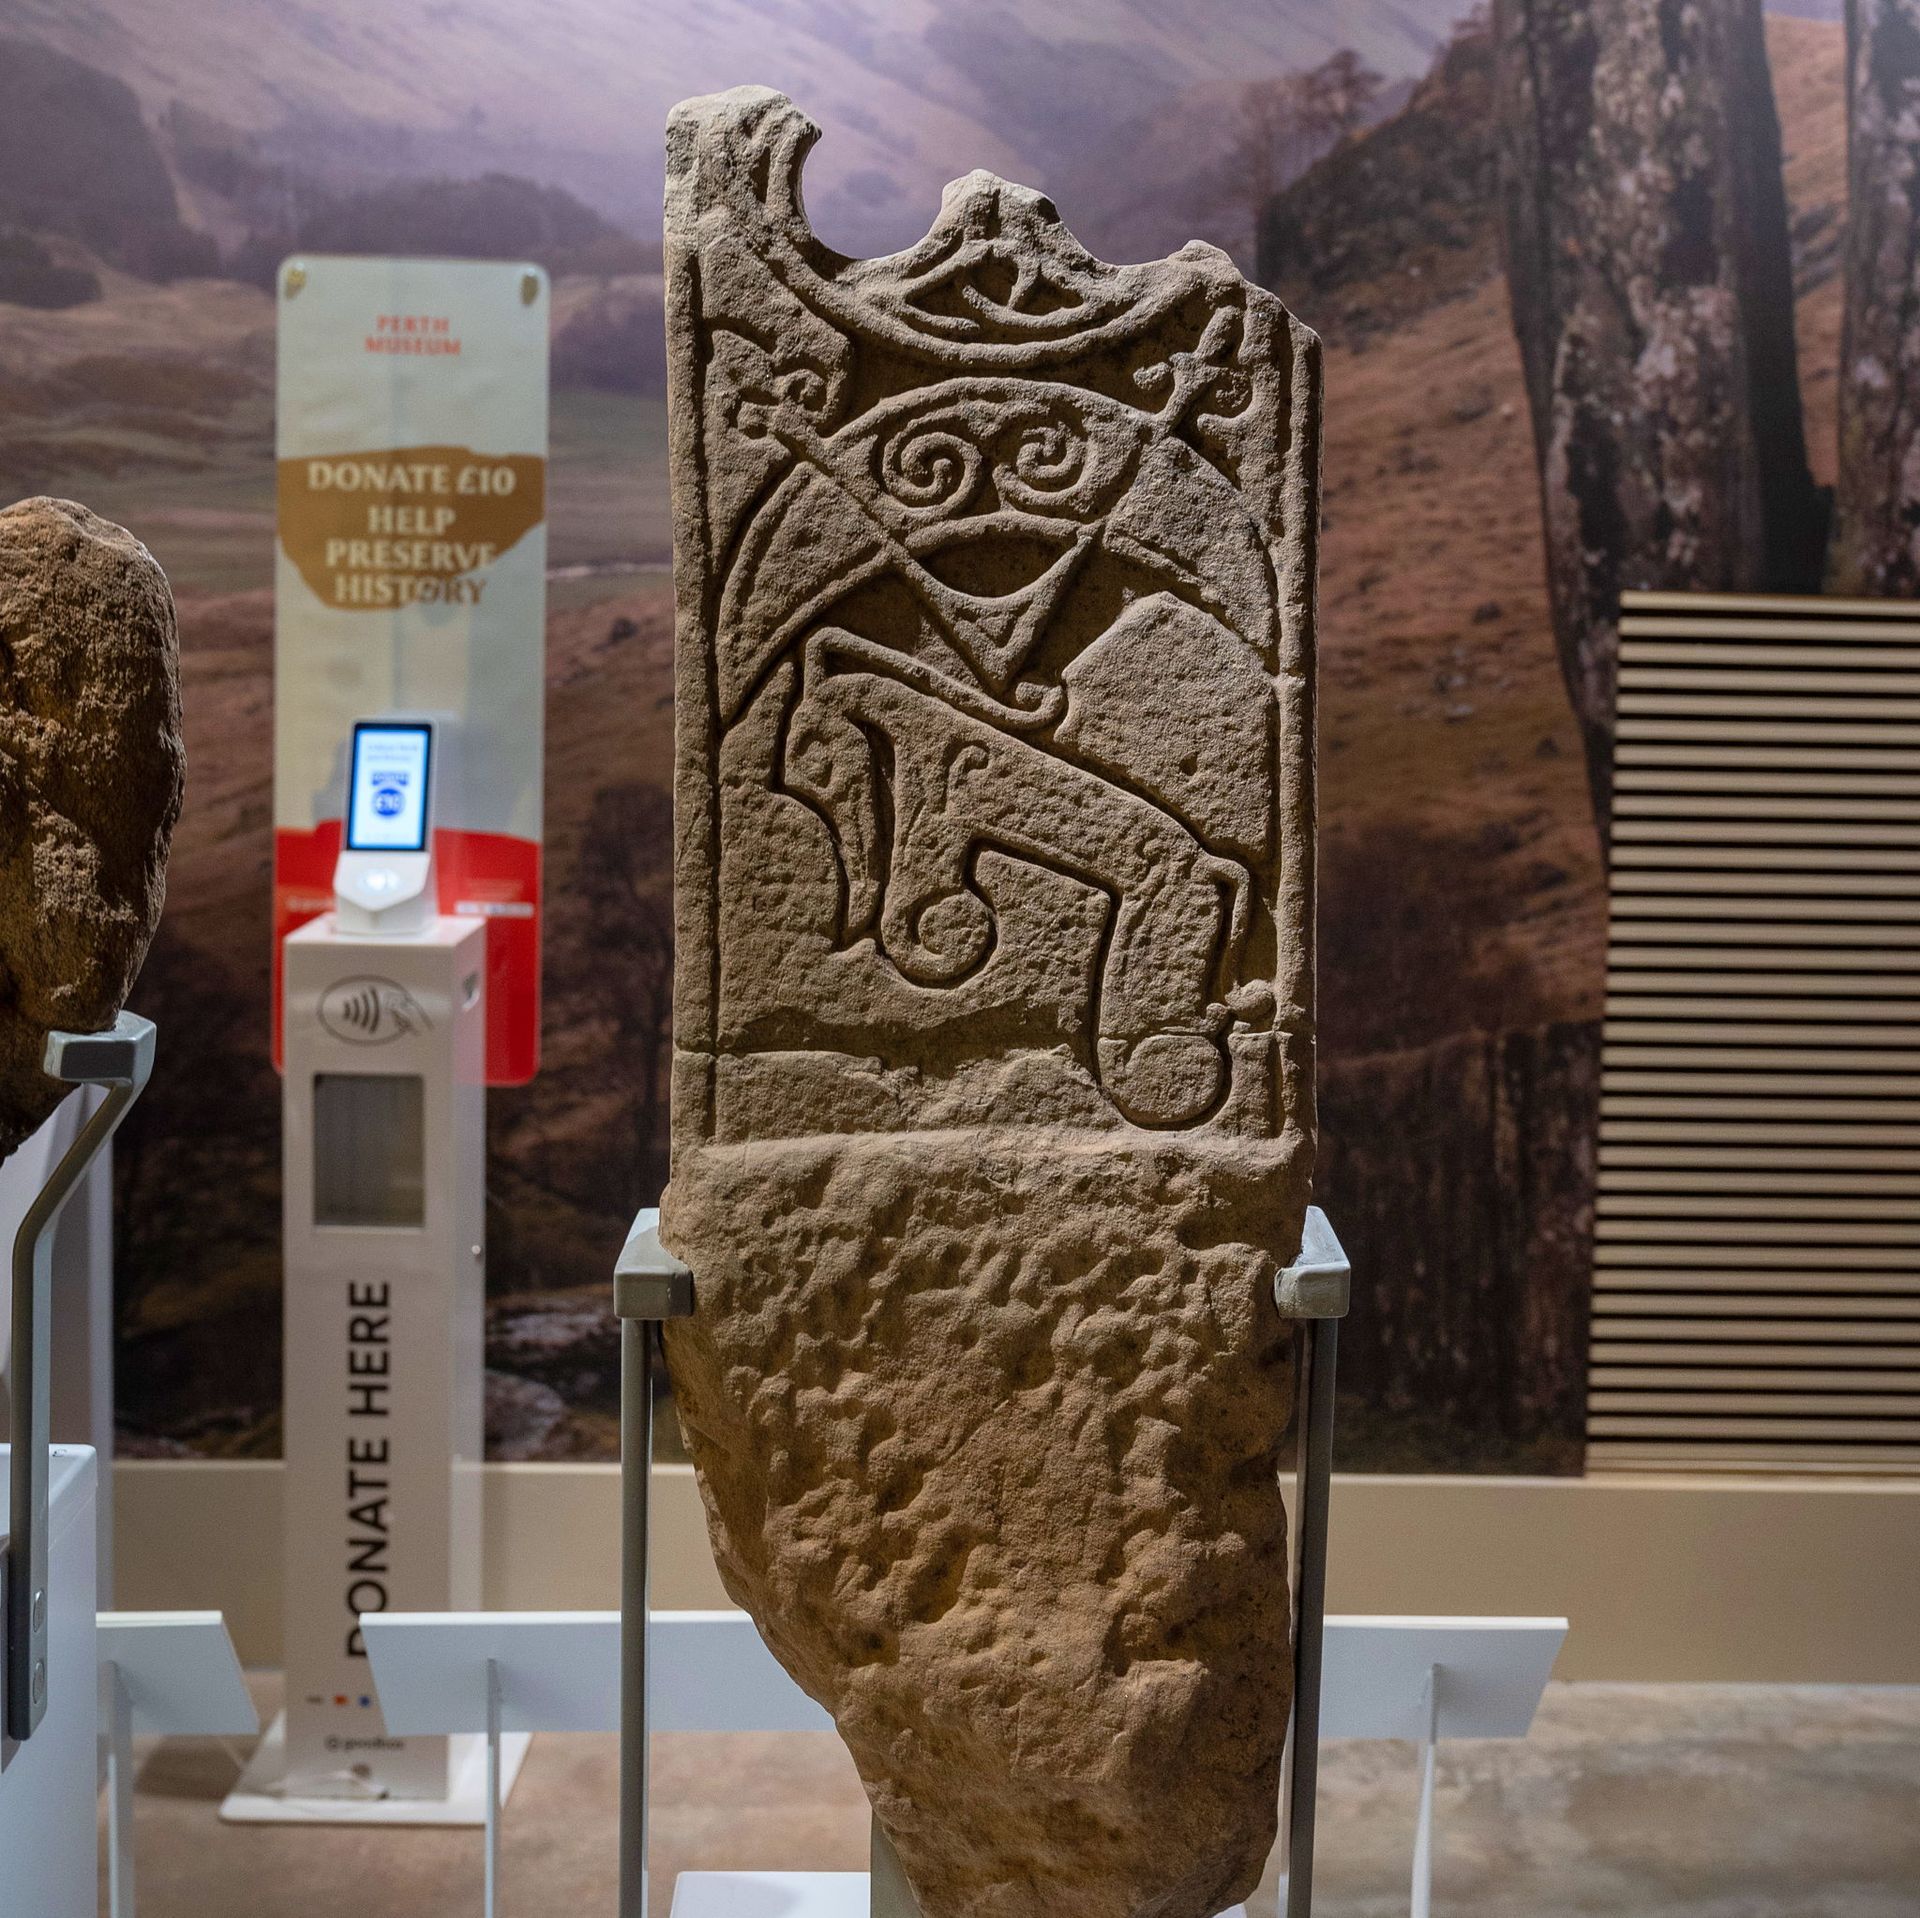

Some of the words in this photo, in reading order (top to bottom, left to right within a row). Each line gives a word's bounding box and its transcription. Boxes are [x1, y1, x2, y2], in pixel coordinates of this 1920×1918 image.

[376, 314, 450, 334] PERTH
[363, 335, 462, 356] MUSEUM
[308, 461, 450, 494] DONATE
[456, 465, 517, 496] £10
[367, 504, 457, 536] HELP
[325, 538, 497, 571] PRESERVE
[334, 573, 487, 606] HISTORY
[348, 1280, 390, 1417] HERE
